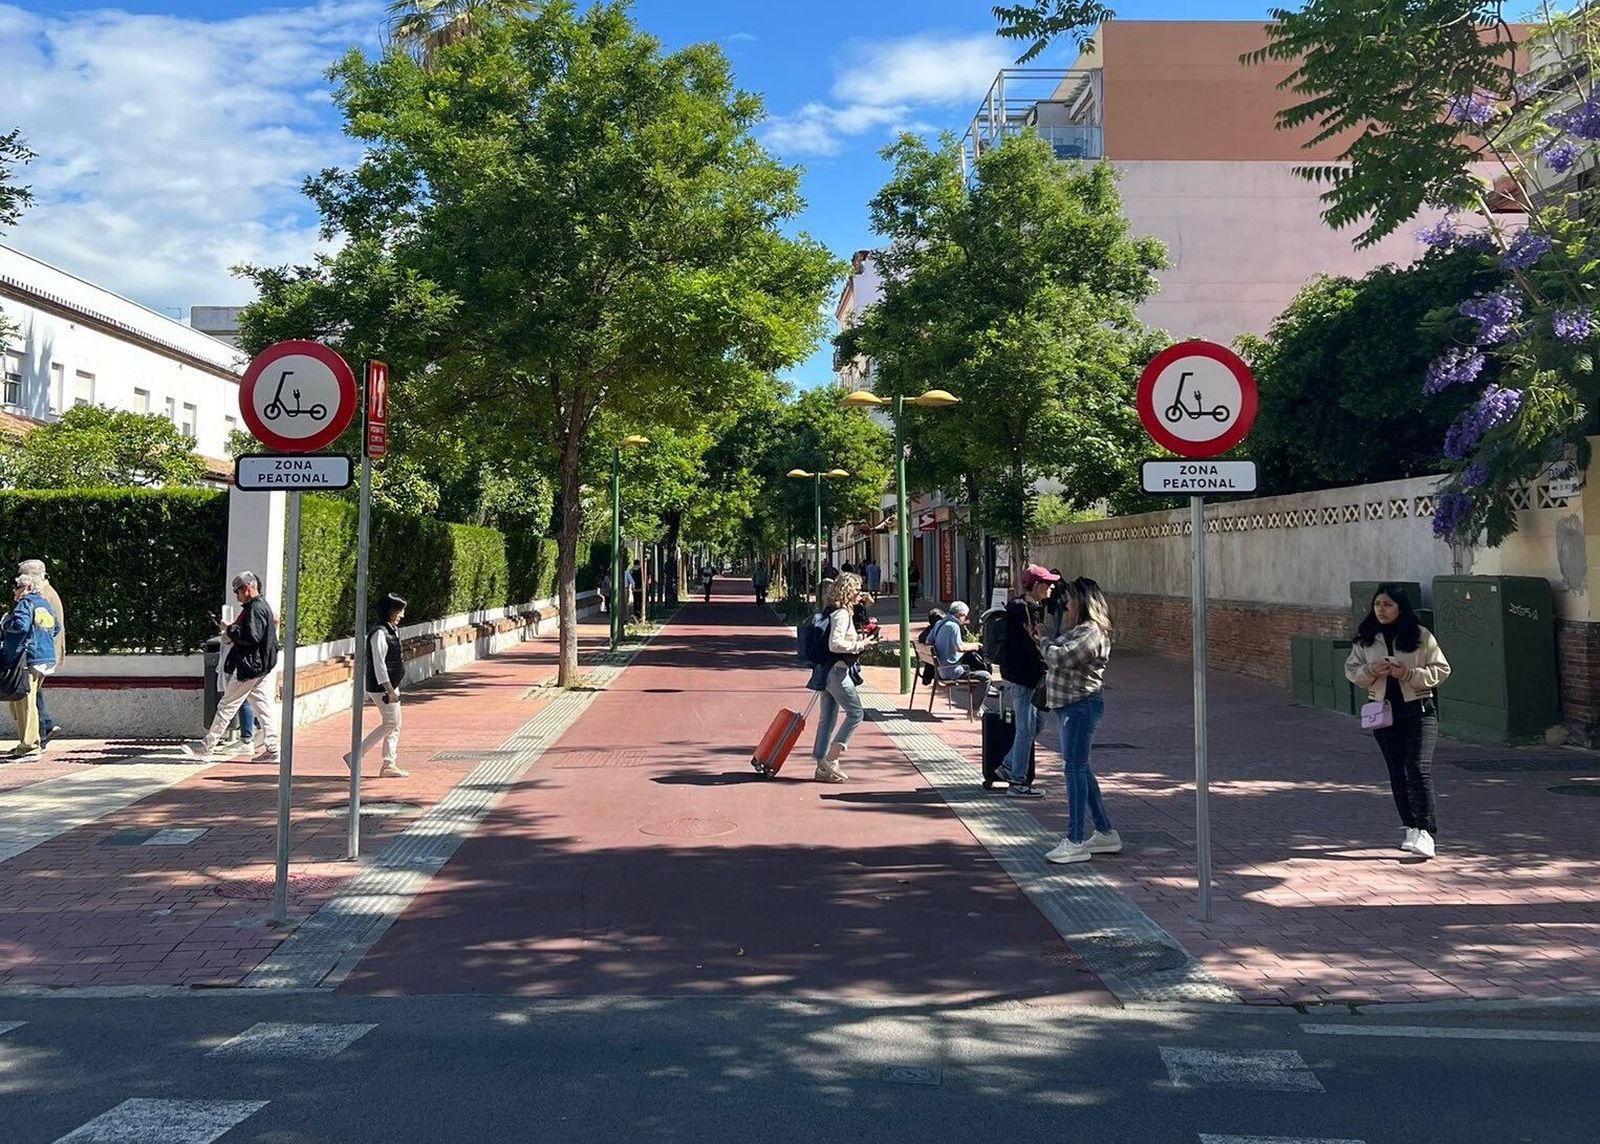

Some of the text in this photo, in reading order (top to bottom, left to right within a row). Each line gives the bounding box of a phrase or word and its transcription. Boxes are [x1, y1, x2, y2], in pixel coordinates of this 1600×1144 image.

[275, 460, 313, 470] ZONA
[1180, 465, 1218, 475] ZONA
[258, 473, 329, 483] PEATONAL
[1163, 478, 1236, 488] PEATONAL
